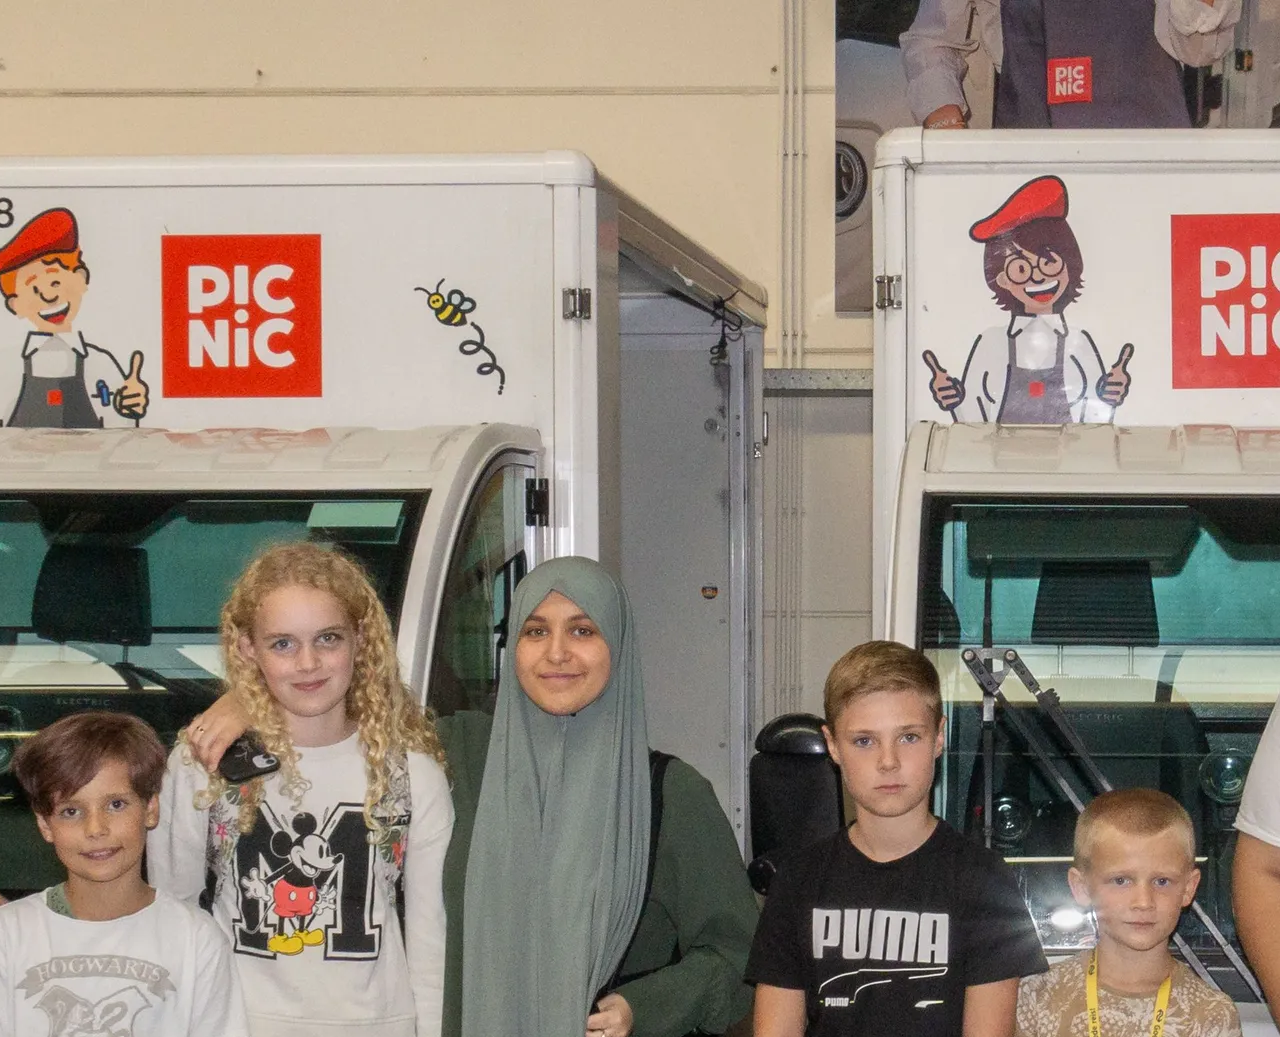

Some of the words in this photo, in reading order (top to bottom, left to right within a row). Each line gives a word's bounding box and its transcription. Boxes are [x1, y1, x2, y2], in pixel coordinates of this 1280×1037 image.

[188, 264, 296, 314] PIC
[812, 907, 949, 964] PUMA
[37, 957, 162, 982] HOGWARTS
[825, 997, 849, 1007] PUMA
